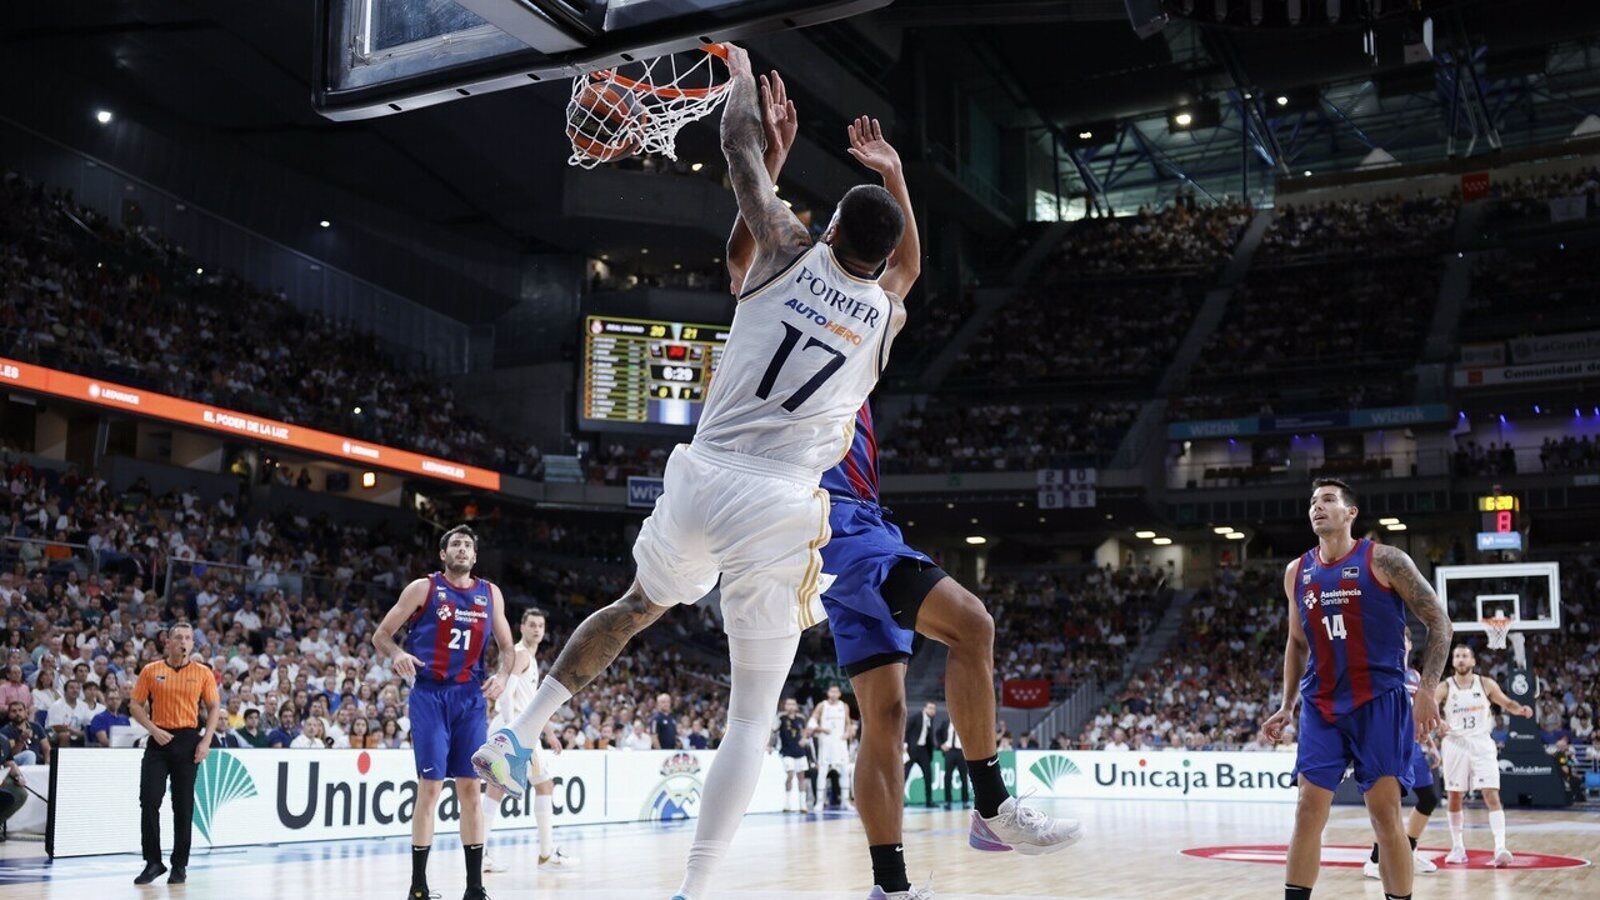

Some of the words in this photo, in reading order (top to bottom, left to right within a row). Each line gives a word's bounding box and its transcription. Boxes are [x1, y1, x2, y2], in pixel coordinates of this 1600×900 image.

[795, 265, 880, 329] POIRIER
[649, 324, 666, 338] 20
[784, 298, 863, 346] AUTOHERO
[755, 320, 847, 413] 17
[1503, 362, 1583, 379] Comunidad
[247, 419, 260, 433] DE
[448, 627, 471, 650] 21
[1322, 614, 1347, 640] 14
[1463, 716, 1476, 730] 13
[1094, 759, 1208, 795] Unicaja
[1216, 763, 1292, 789] Banc
[277, 751, 460, 830] Unicaa
